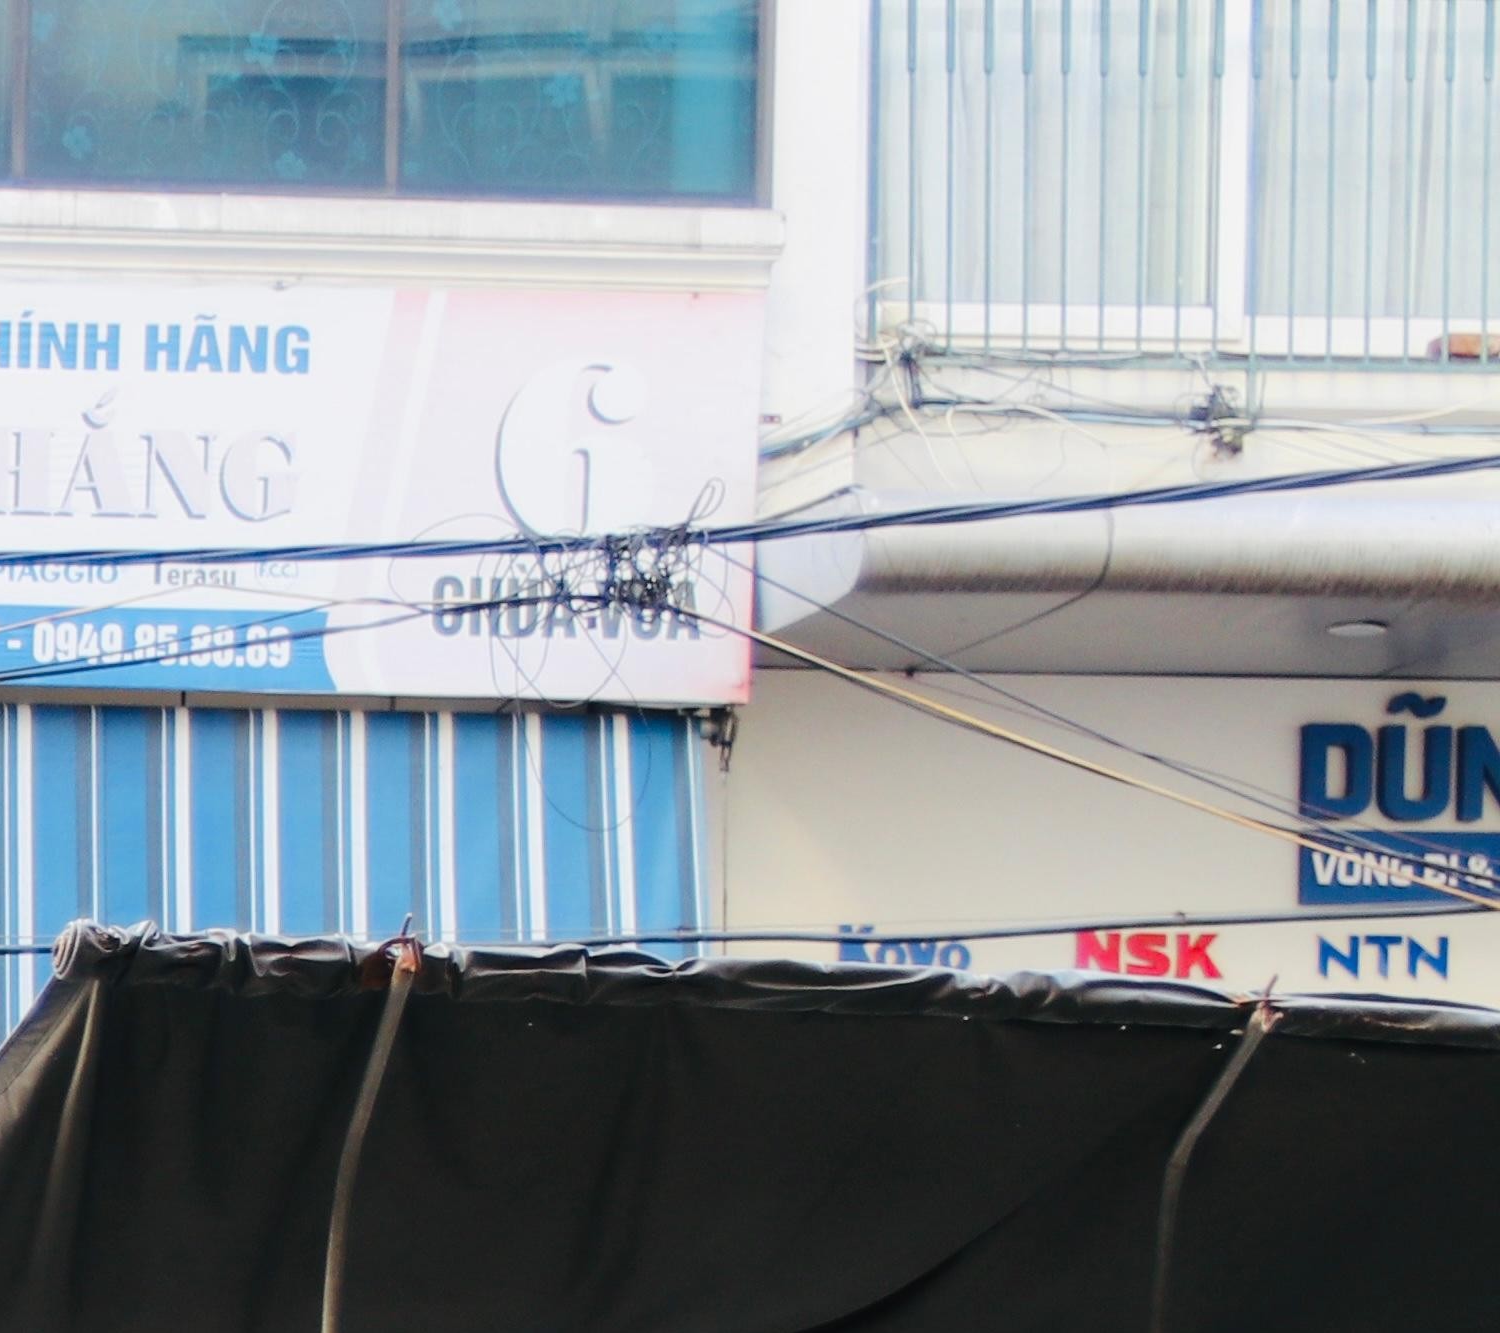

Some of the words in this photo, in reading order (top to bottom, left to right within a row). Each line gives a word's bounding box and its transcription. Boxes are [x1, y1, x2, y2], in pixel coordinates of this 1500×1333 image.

[144, 313, 310, 374] HÃNG
[1300, 691, 1500, 823] DŨN
[1075, 928, 1222, 979] NSK
[1318, 935, 1450, 979] NTN
